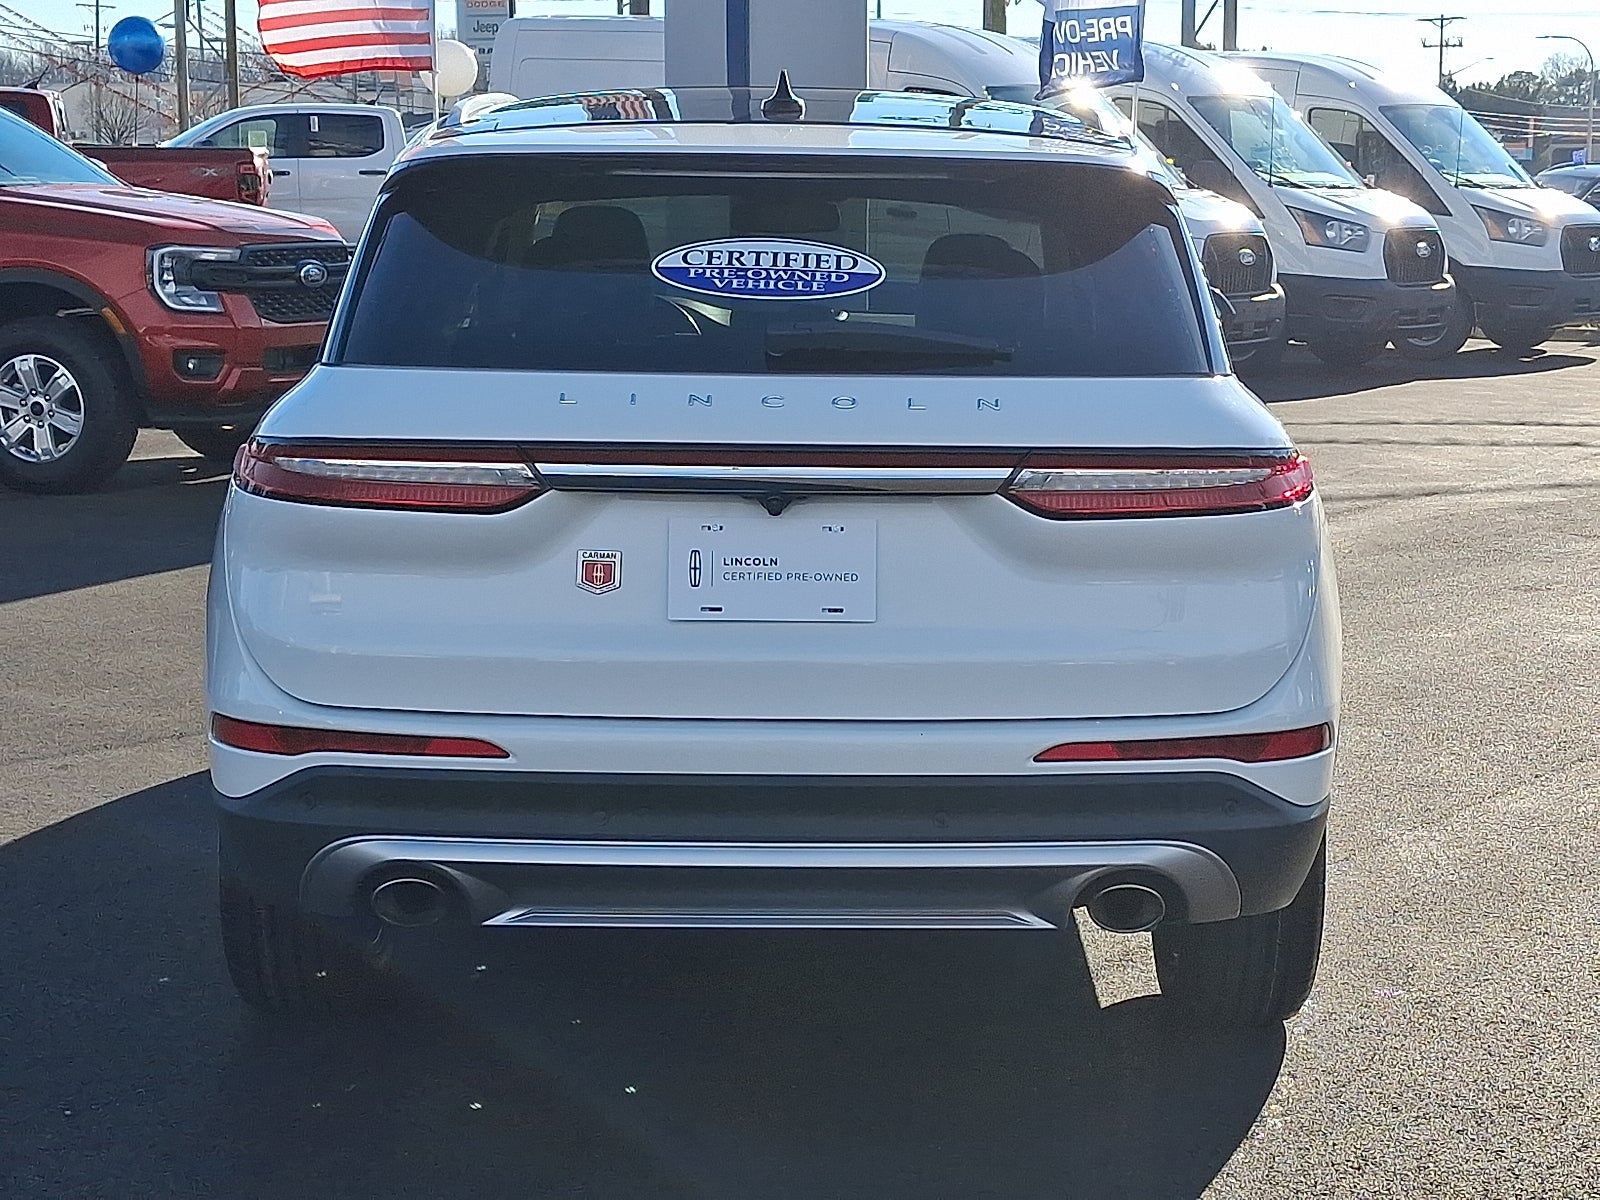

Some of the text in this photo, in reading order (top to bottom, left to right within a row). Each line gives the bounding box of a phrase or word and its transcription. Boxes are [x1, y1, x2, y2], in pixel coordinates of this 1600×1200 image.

[466, 0, 505, 8] DODGE
[472, 20, 499, 35] Jeep
[681, 249, 860, 272] CERTIFIED
[688, 268, 850, 283] PRE-OWNED
[712, 278, 826, 292] VEHICLE
[559, 392, 1000, 411] LINCOLN
[582, 551, 617, 560] CARMAN
[722, 556, 779, 567] LINCOLN
[722, 571, 859, 583] CERTIFIED PRE-OWNED
